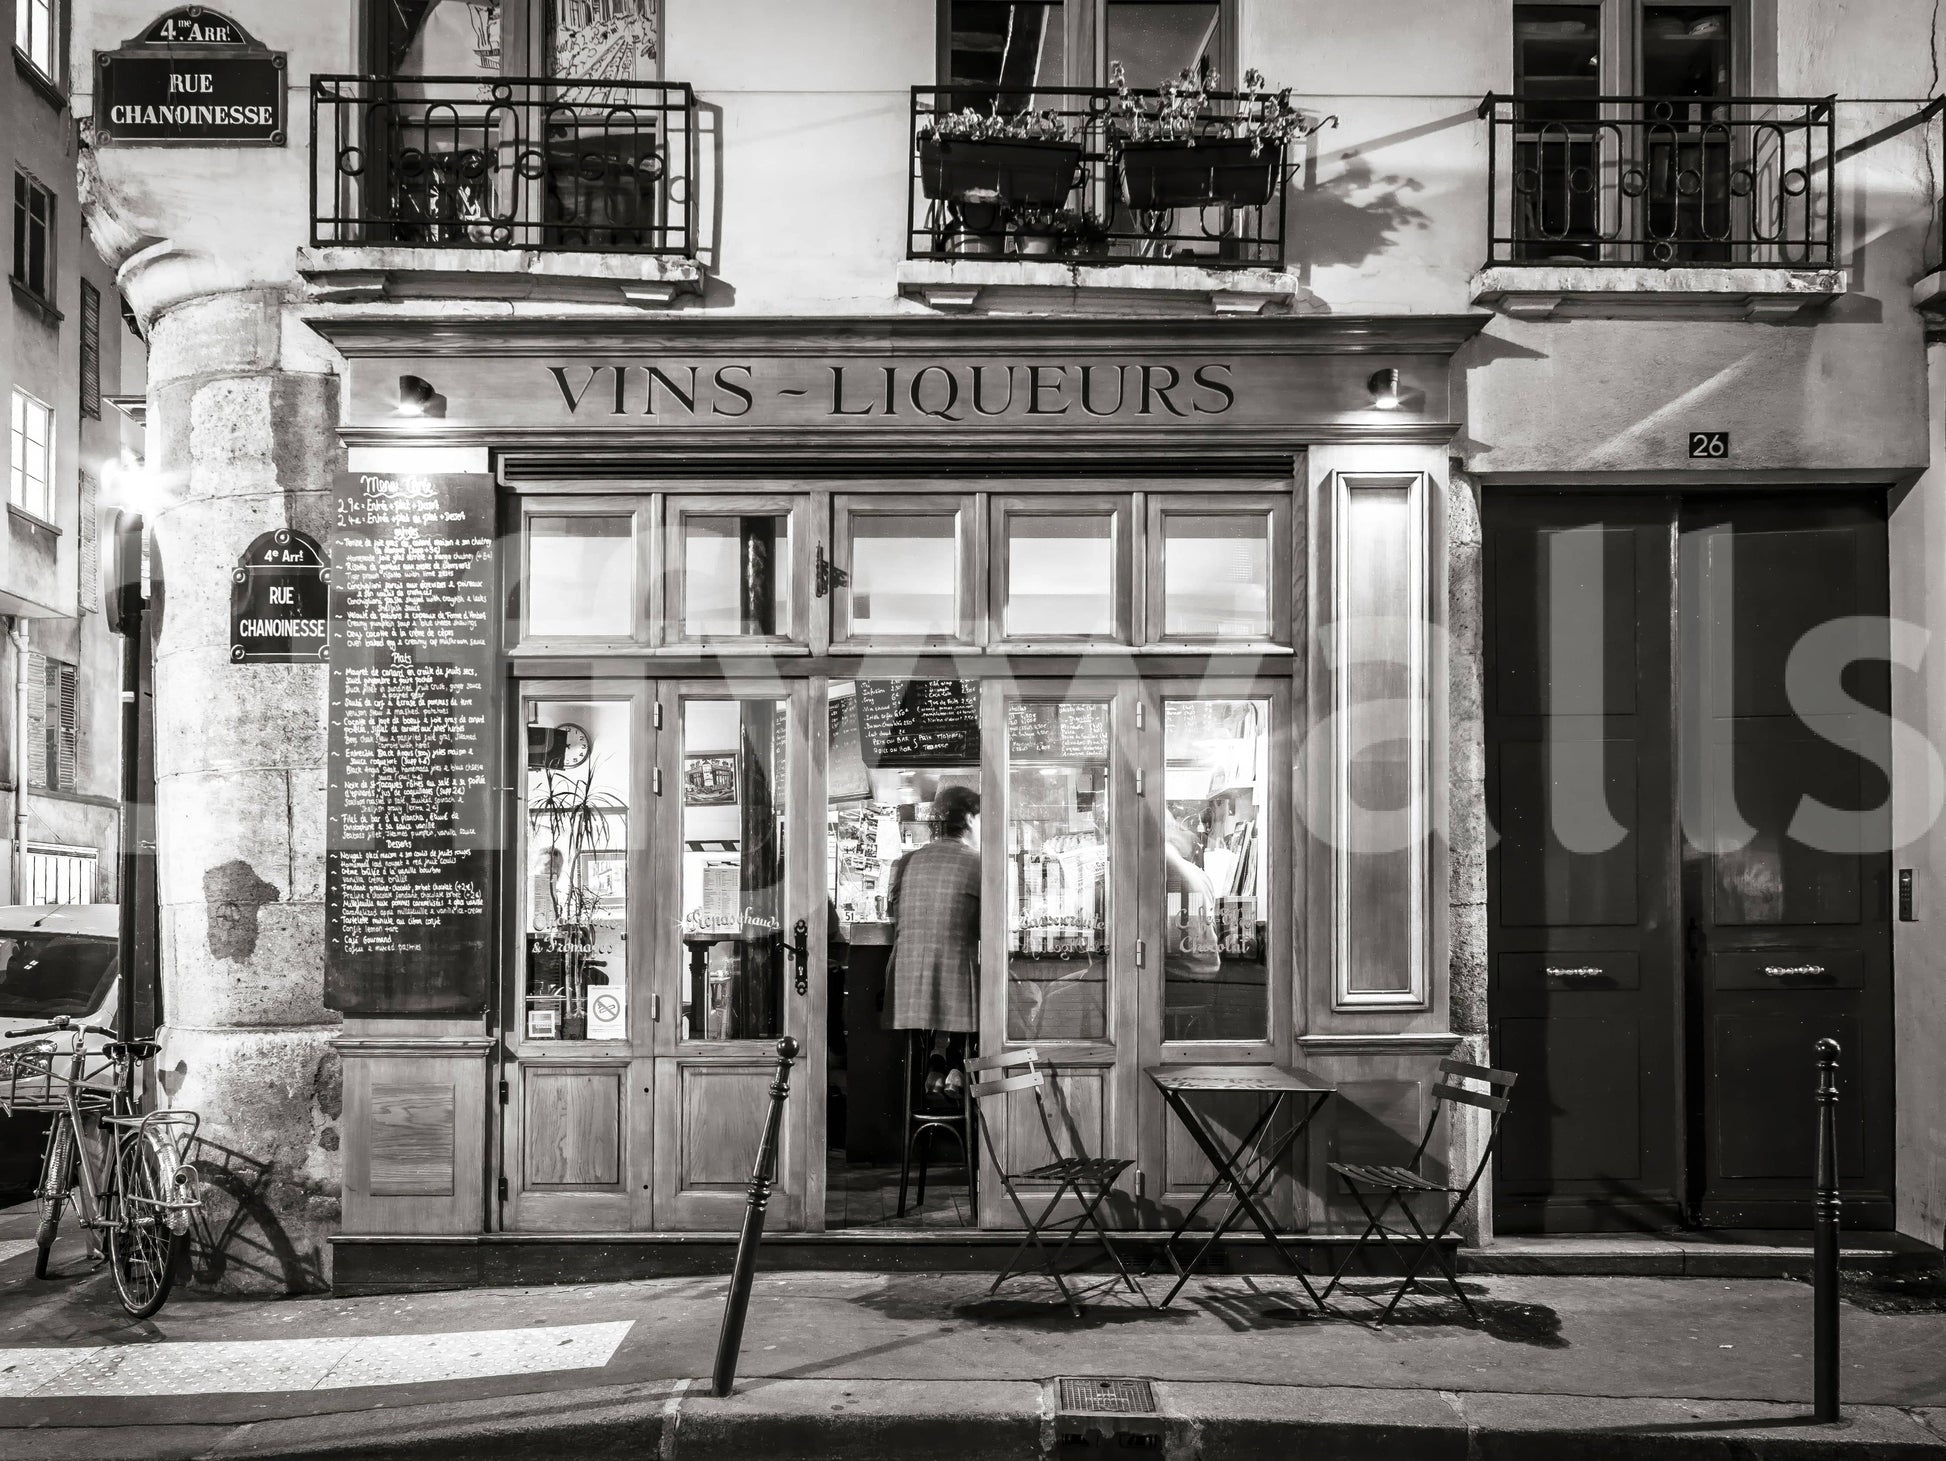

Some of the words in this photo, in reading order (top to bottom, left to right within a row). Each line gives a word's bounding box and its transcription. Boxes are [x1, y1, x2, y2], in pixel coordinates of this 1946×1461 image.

[170, 74, 213, 93] RUE
[111, 105, 273, 125] CHANOINESSE
[547, 363, 753, 417] VINS
[829, 363, 1238, 422] LIQUEURS
[1693, 434, 1725, 456] 26
[264, 549, 279, 562] 4e
[269, 586, 295, 604] RUE
[240, 619, 326, 637] CHANOINESSE
[391, 652, 412, 664] Plats
[846, 911, 854, 921] 51
